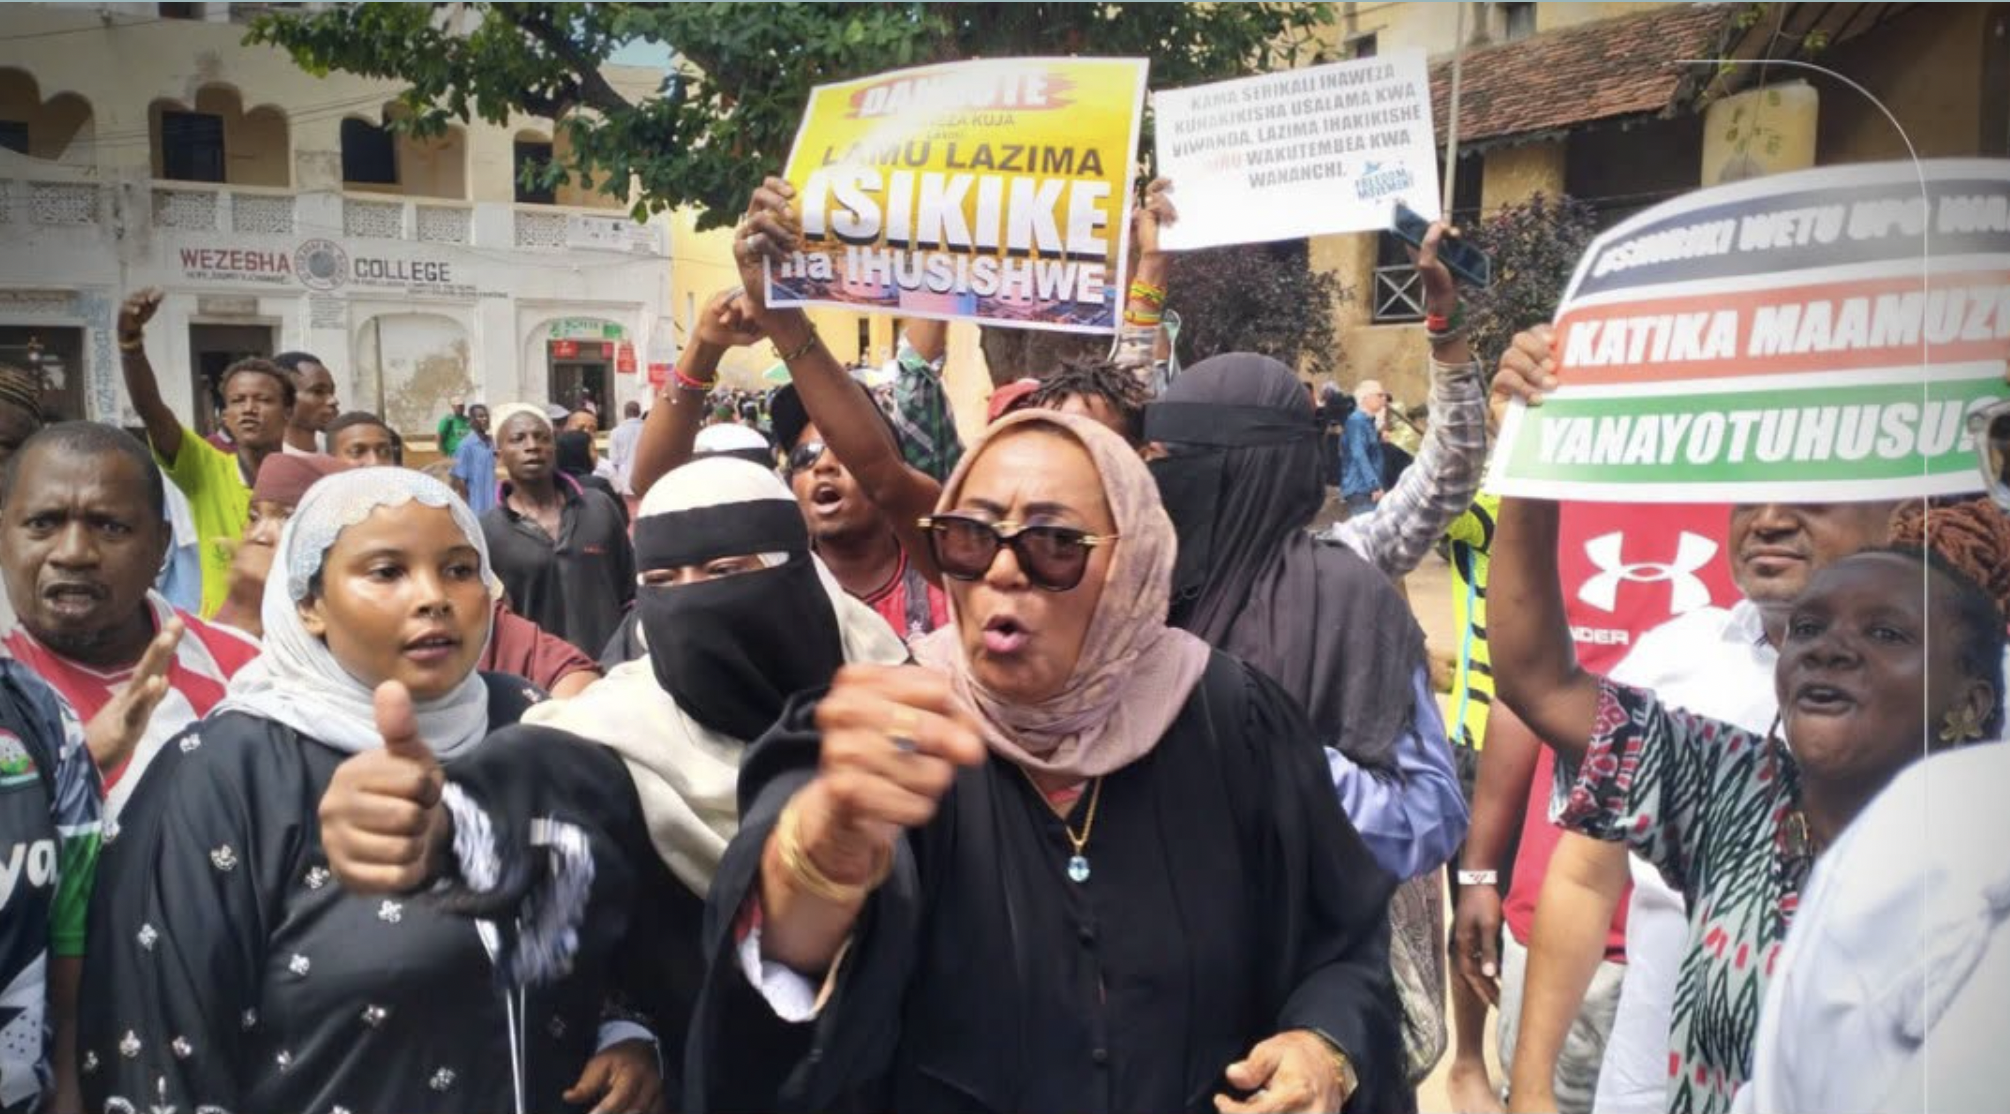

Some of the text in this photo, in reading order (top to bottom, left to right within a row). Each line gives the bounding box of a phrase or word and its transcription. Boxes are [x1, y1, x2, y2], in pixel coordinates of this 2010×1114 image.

[859, 71, 1049, 118] DATE
[1320, 63, 1395, 90] INAWEZA
[972, 114, 1015, 127] KUJA
[1174, 82, 1416, 134] KUHAKIKISHA USALAMA KWA
[1258, 120, 1318, 143] LAZIMA
[1323, 104, 1421, 133] IHAKIKISHE
[945, 141, 1105, 177] LAZIMA
[1370, 129, 1411, 150] KWA
[801, 166, 1112, 259] ISIKIKE
[1739, 204, 1846, 252] WETU
[180, 248, 291, 273] WEZESHA
[354, 257, 452, 282] COLLEGE
[844, 246, 1106, 304] IHUSISHWE
[1563, 284, 2010, 368] KATIKA MAAMUZI
[1569, 626, 1630, 646] NDER
